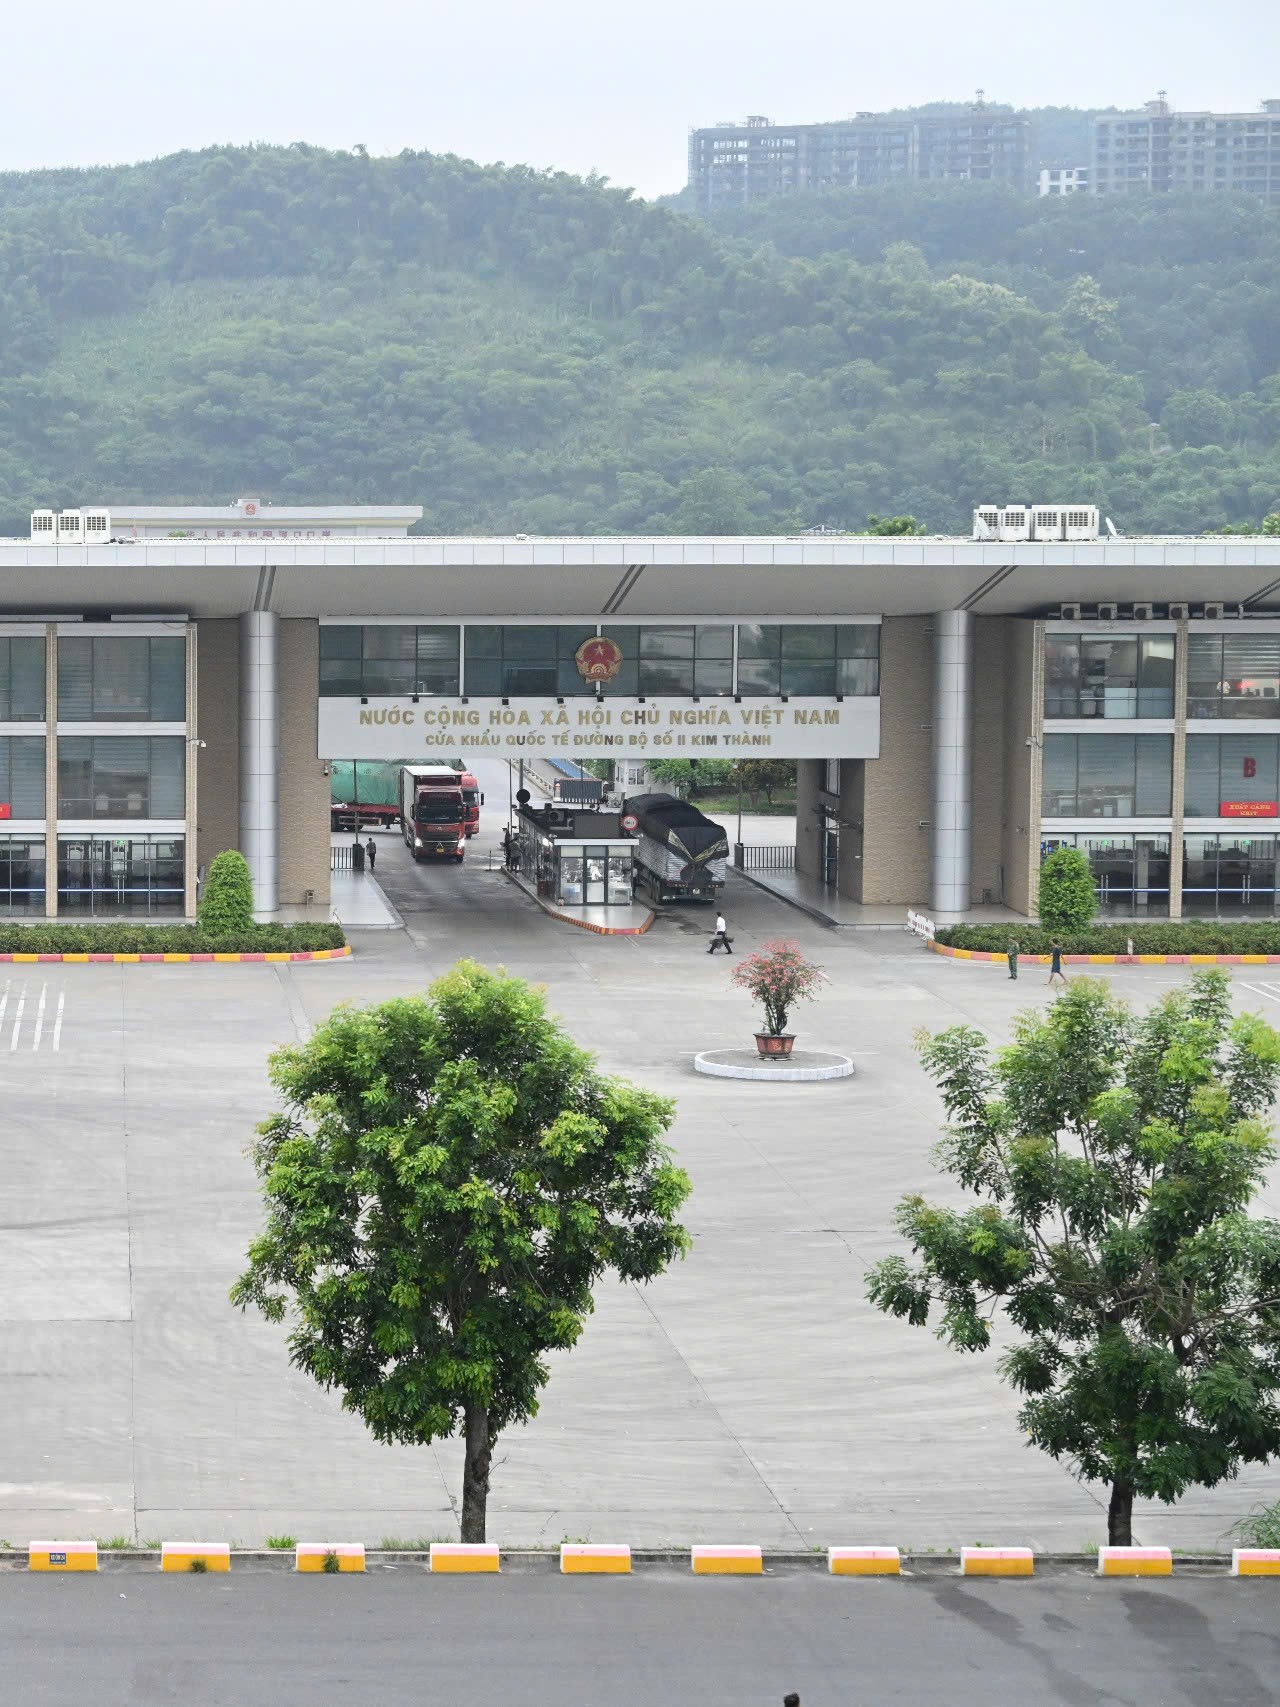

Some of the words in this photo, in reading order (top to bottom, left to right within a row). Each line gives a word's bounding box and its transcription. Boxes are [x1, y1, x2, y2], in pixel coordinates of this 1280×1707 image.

[360, 705, 415, 725] NƯỚC
[424, 705, 480, 729] CỘNG
[489, 706, 531, 725] HÒA
[541, 705, 570, 725] XÃ
[578, 705, 612, 729] HỘI
[621, 703, 660, 725] CHỦ
[670, 705, 731, 725] NGHĨA
[740, 705, 784, 729] VIỆT
[794, 709, 840, 725] NAM
[425, 730, 455, 746] CỬA
[461, 728, 501, 746] KHẨU
[506, 729, 546, 746] QUỐC
[552, 729, 570, 746] TẾ
[573, 731, 623, 746] ĐƯỜNG
[629, 731, 648, 749] BỘ
[653, 729, 674, 746] SỐ
[678, 734, 686, 746] II
[692, 734, 717, 746] KIM
[723, 731, 771, 746] THÀNH
[1243, 757, 1256, 778] B
